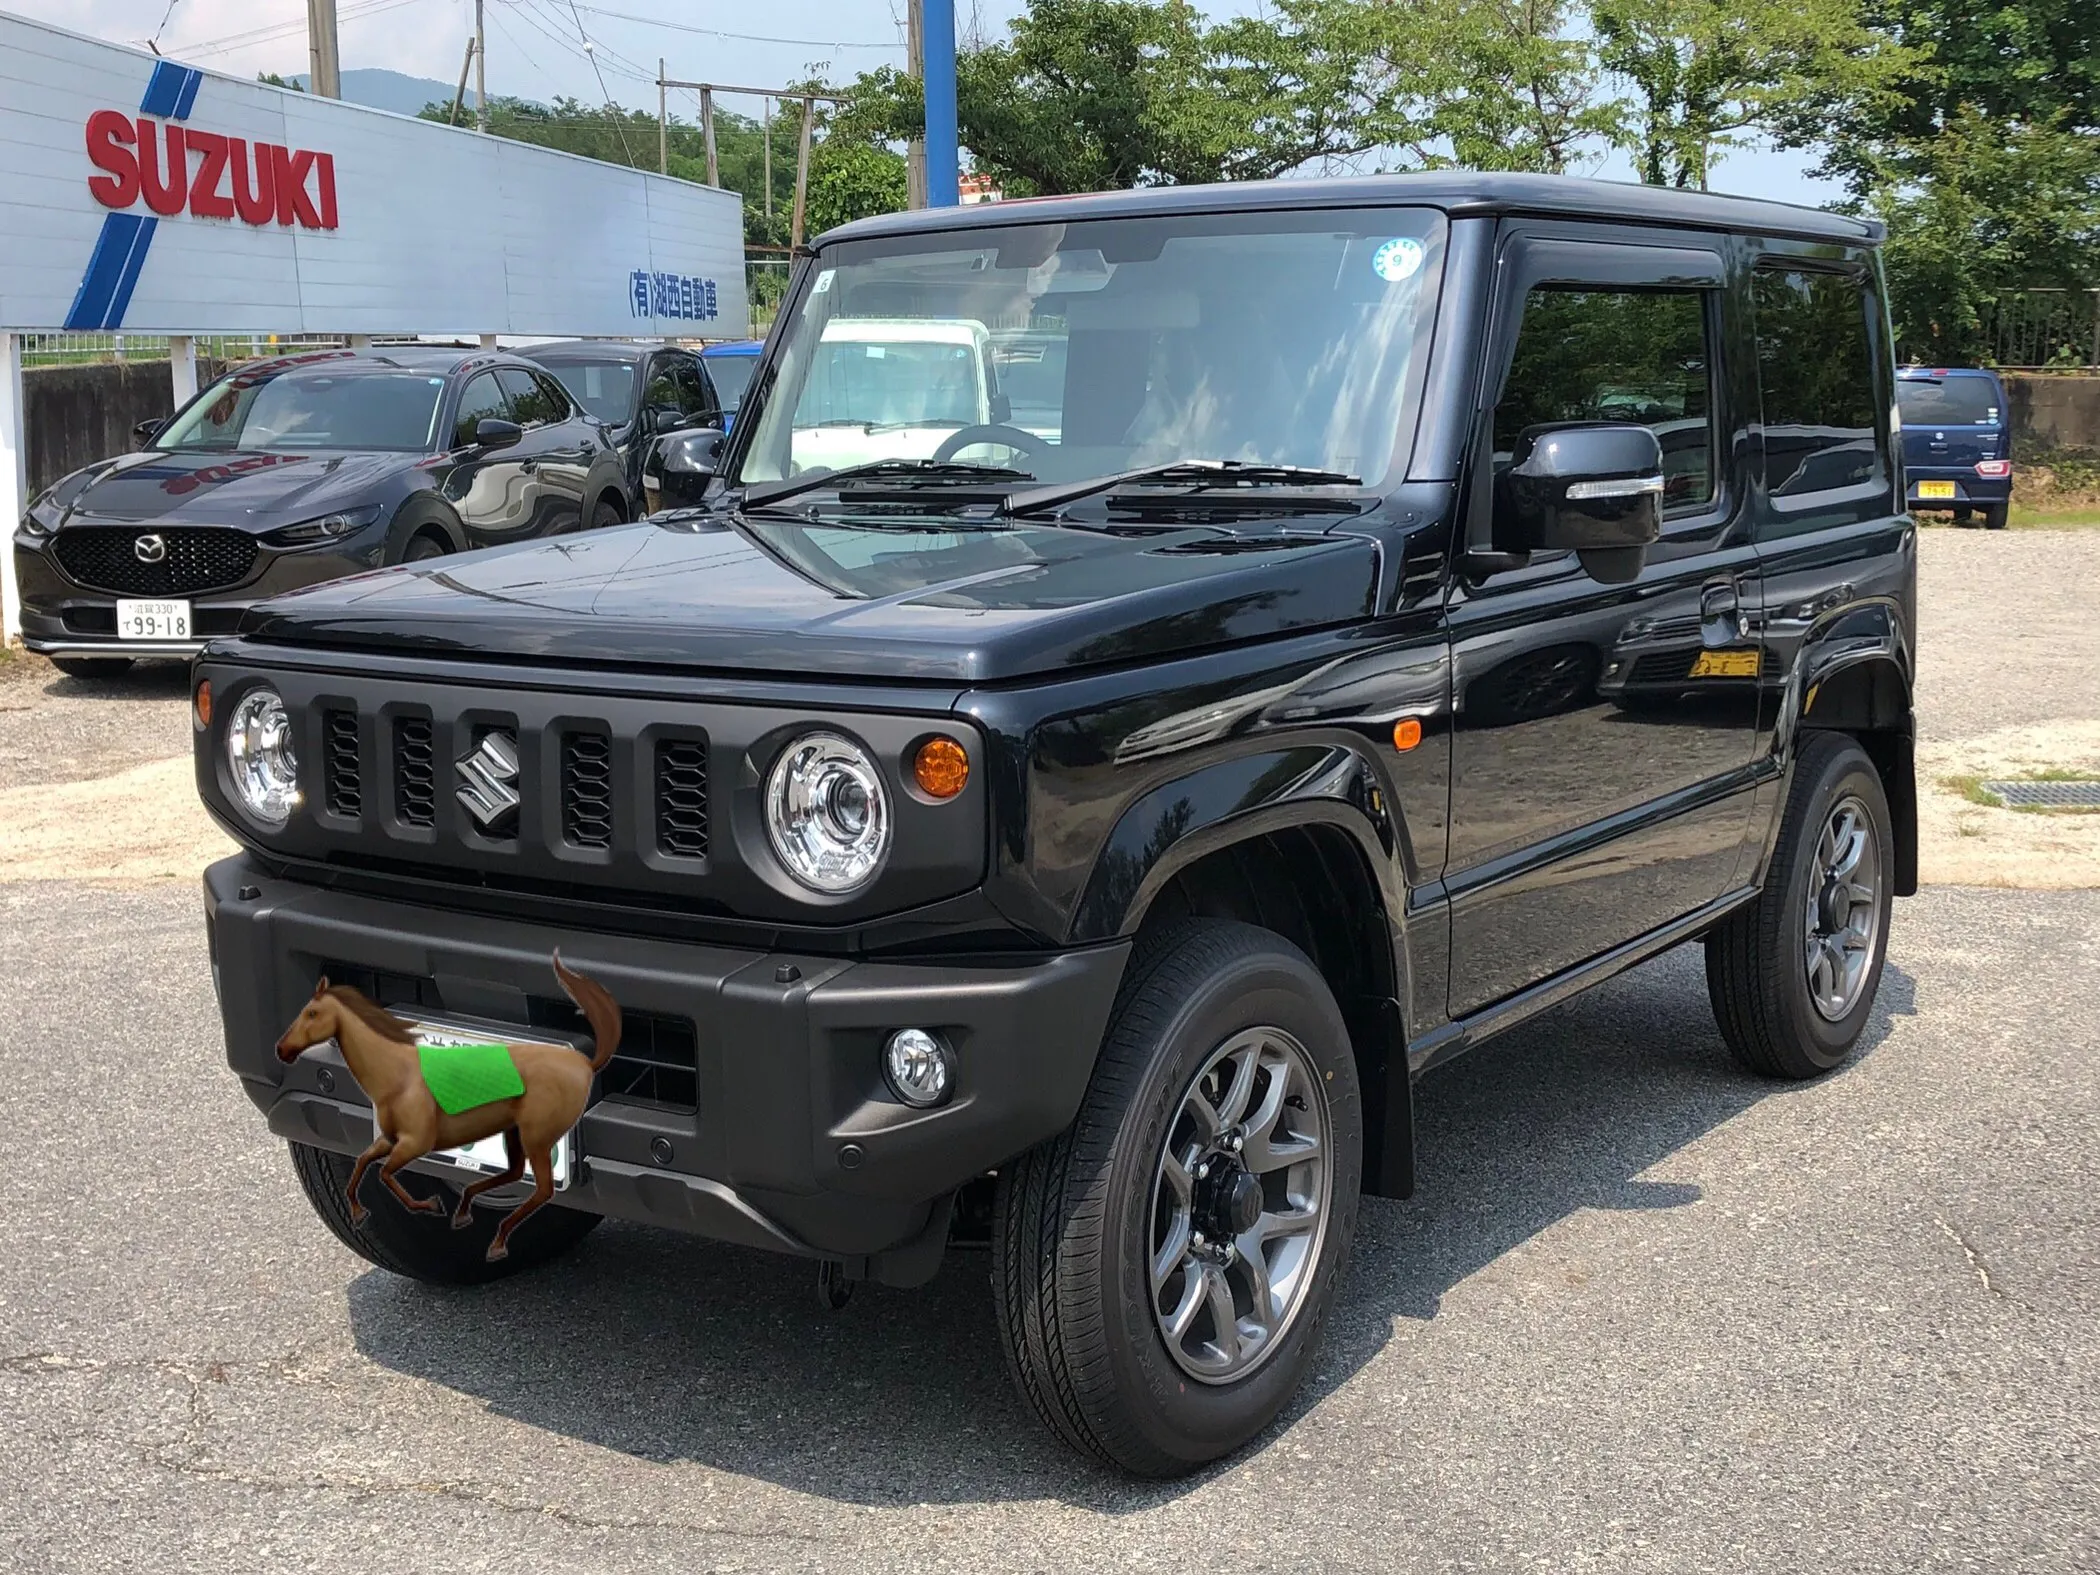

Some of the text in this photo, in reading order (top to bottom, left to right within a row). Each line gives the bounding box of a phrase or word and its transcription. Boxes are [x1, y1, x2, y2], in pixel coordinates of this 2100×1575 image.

[85, 109, 339, 230] SUZUKI
[629, 268, 718, 321] (有)湖西自動車
[134, 616, 186, 636] 99-18
[457, 1159, 479, 1168] SUZUKI
